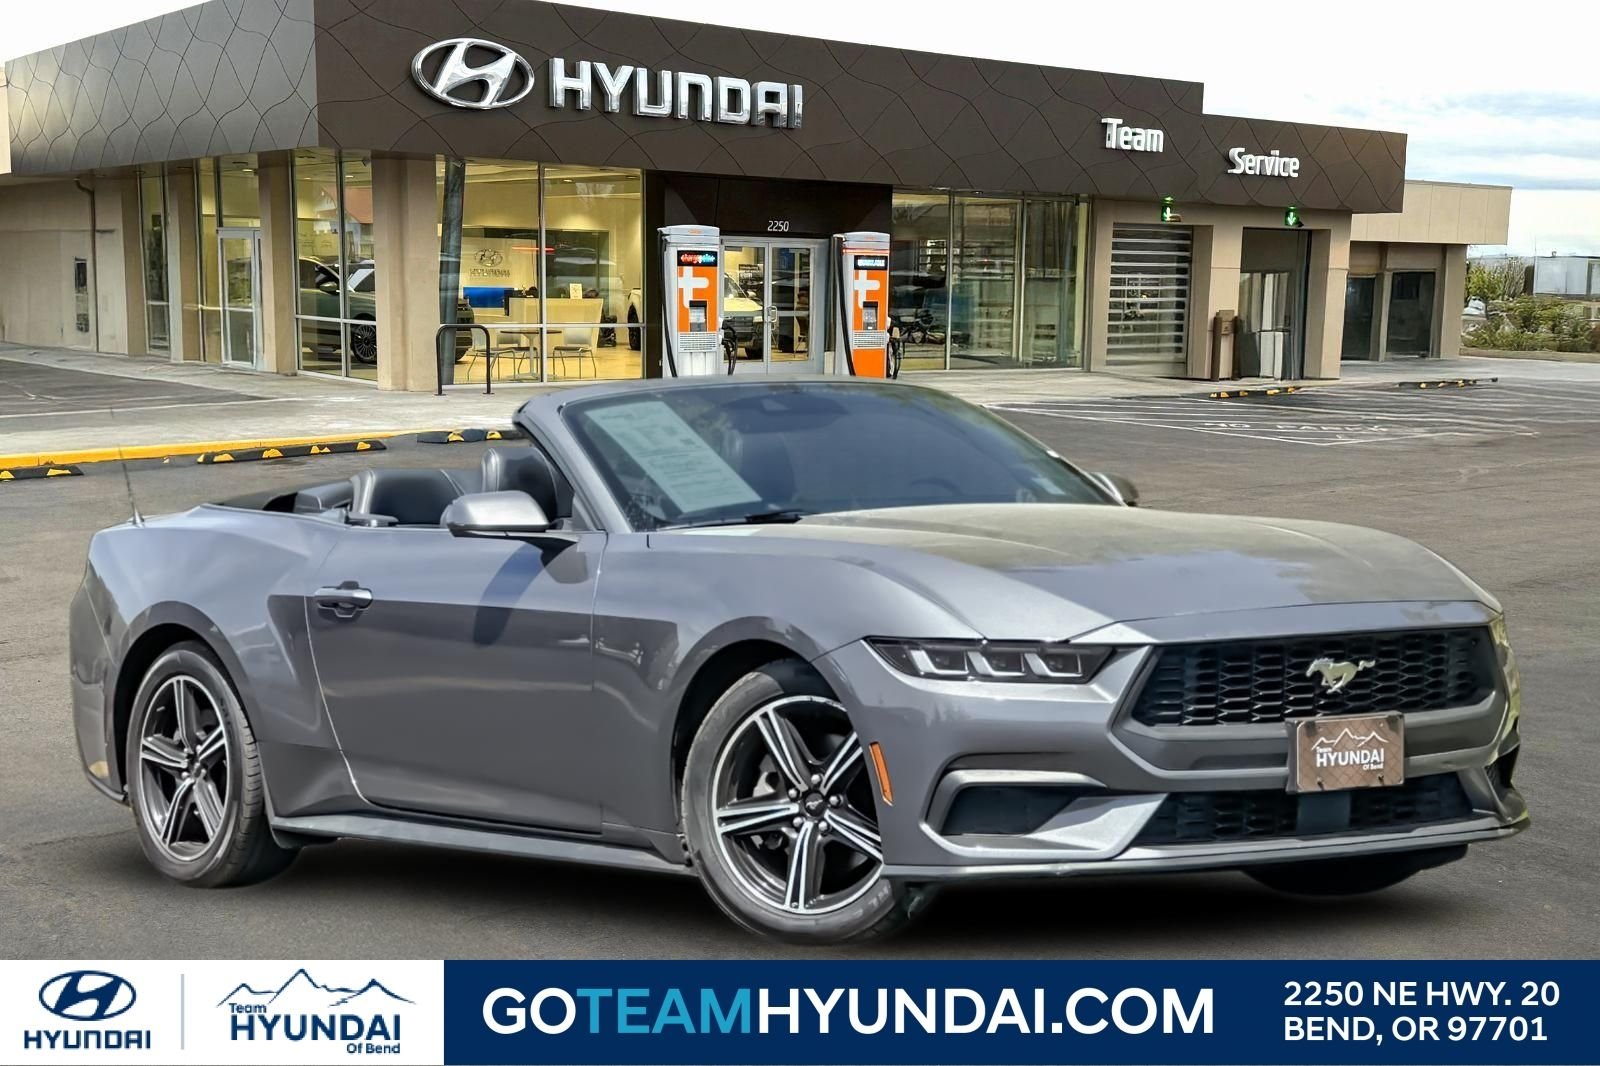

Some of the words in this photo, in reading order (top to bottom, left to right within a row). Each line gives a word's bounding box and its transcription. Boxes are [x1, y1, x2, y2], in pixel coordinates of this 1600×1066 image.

[549, 57, 803, 128] HYUNDAI
[1101, 118, 1163, 152] Team
[1227, 147, 1299, 177] Service
[767, 220, 790, 232] 2250
[1316, 748, 1384, 767] HYUNDAI
